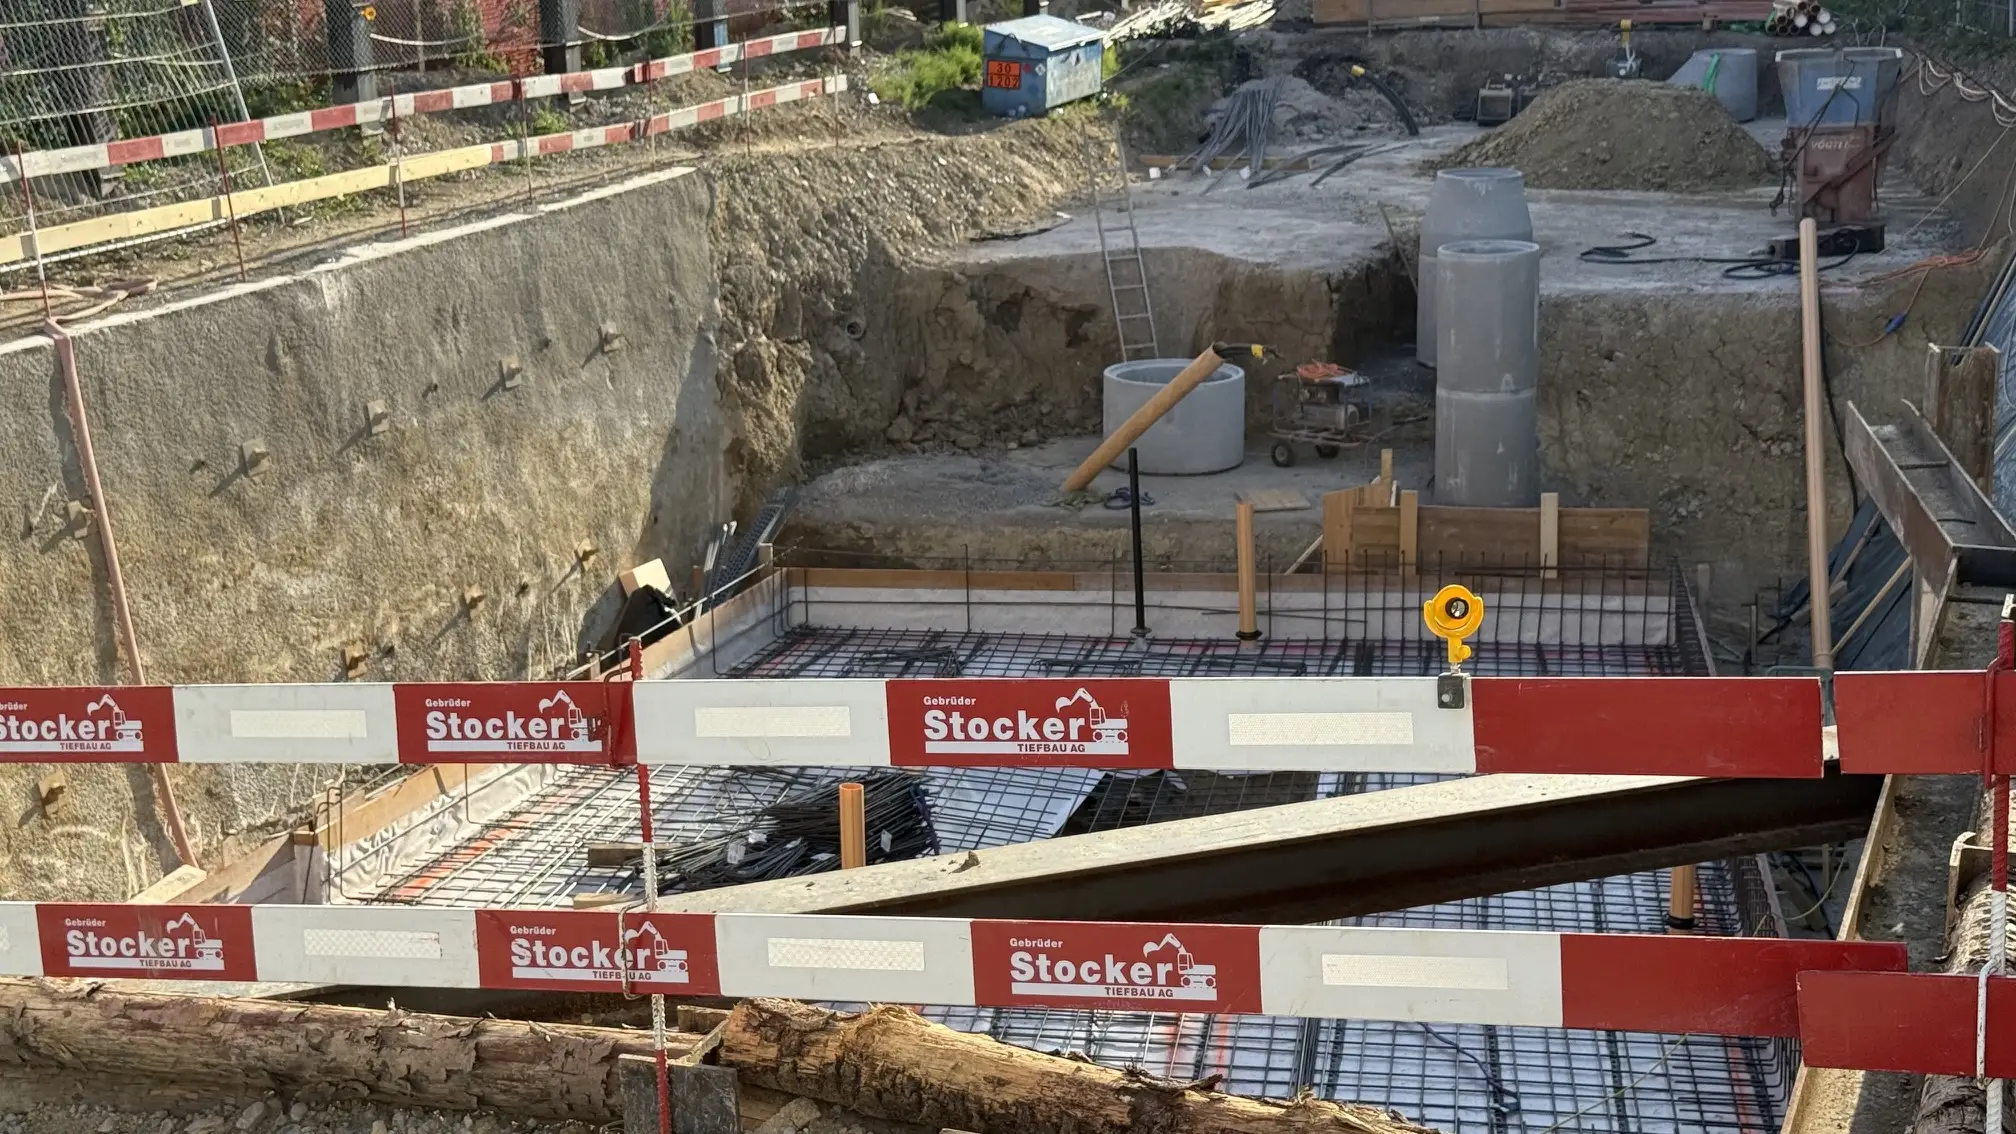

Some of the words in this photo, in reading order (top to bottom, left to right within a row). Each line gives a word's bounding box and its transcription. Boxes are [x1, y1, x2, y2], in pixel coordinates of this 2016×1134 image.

[996, 63, 1012, 74] 30
[989, 75, 1019, 88] 1202
[425, 698, 471, 708] Gebrüder
[923, 696, 977, 706] Gebrüder
[426, 710, 564, 740] Stocker
[923, 709, 1085, 740] Stocker
[60, 742, 98, 751] TIEFBAU
[100, 742, 112, 751] AG
[507, 741, 550, 750] TIEFBAU
[552, 742, 566, 751] AG
[1017, 743, 1067, 753] TIEFBAU
[1070, 743, 1086, 753] AG
[65, 918, 106, 927] Gebrüder
[510, 926, 556, 936] Gebrüder
[66, 929, 190, 957] Stocker
[1009, 937, 1063, 948] Gebrüder
[139, 959, 178, 968] TIEFBAU
[180, 960, 192, 968] AG
[1010, 951, 1173, 985] Stocker
[592, 970, 636, 980] TIEFBU
[638, 972, 651, 980] AG
[1104, 986, 1155, 997] TIEFBAU
[1158, 988, 1173, 998] AG
